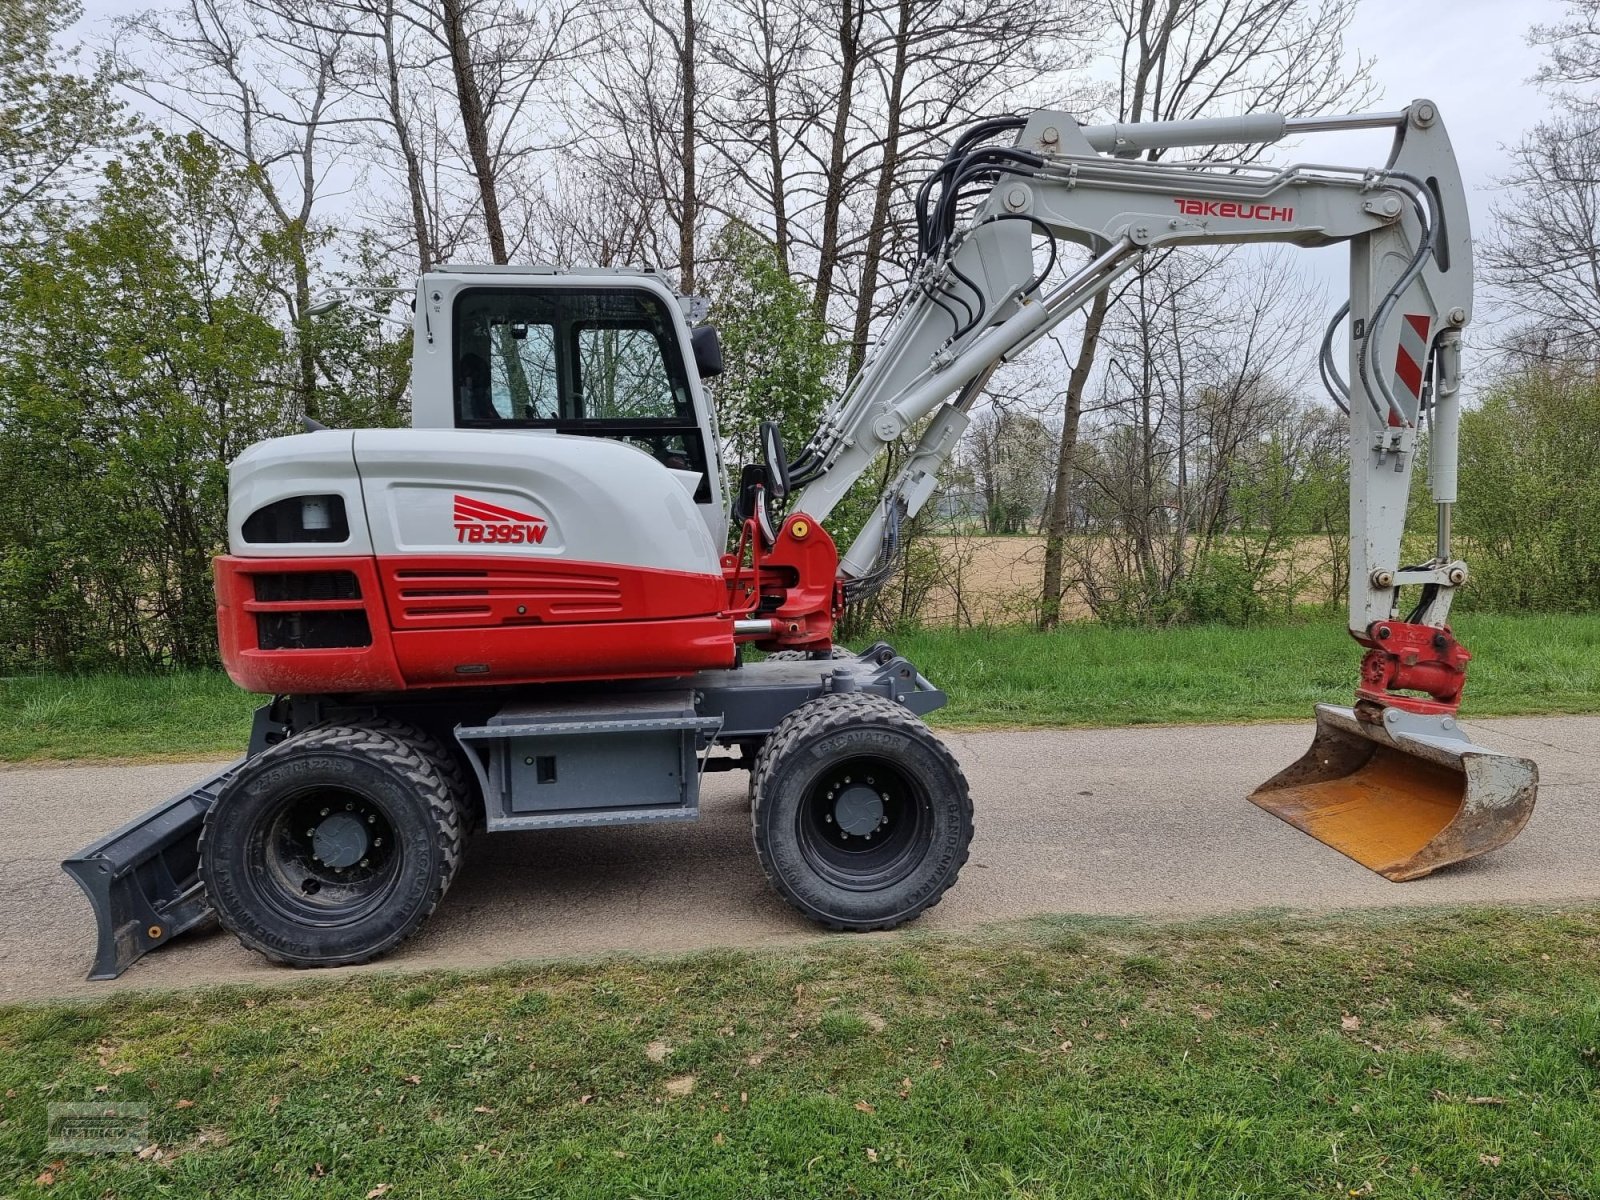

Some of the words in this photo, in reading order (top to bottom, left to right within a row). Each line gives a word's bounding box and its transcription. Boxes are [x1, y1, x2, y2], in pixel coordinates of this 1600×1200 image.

[1174, 199, 1294, 222] TAKEUCHI
[454, 523, 549, 544] TB395W
[818, 731, 902, 752] EXCAVATOR
